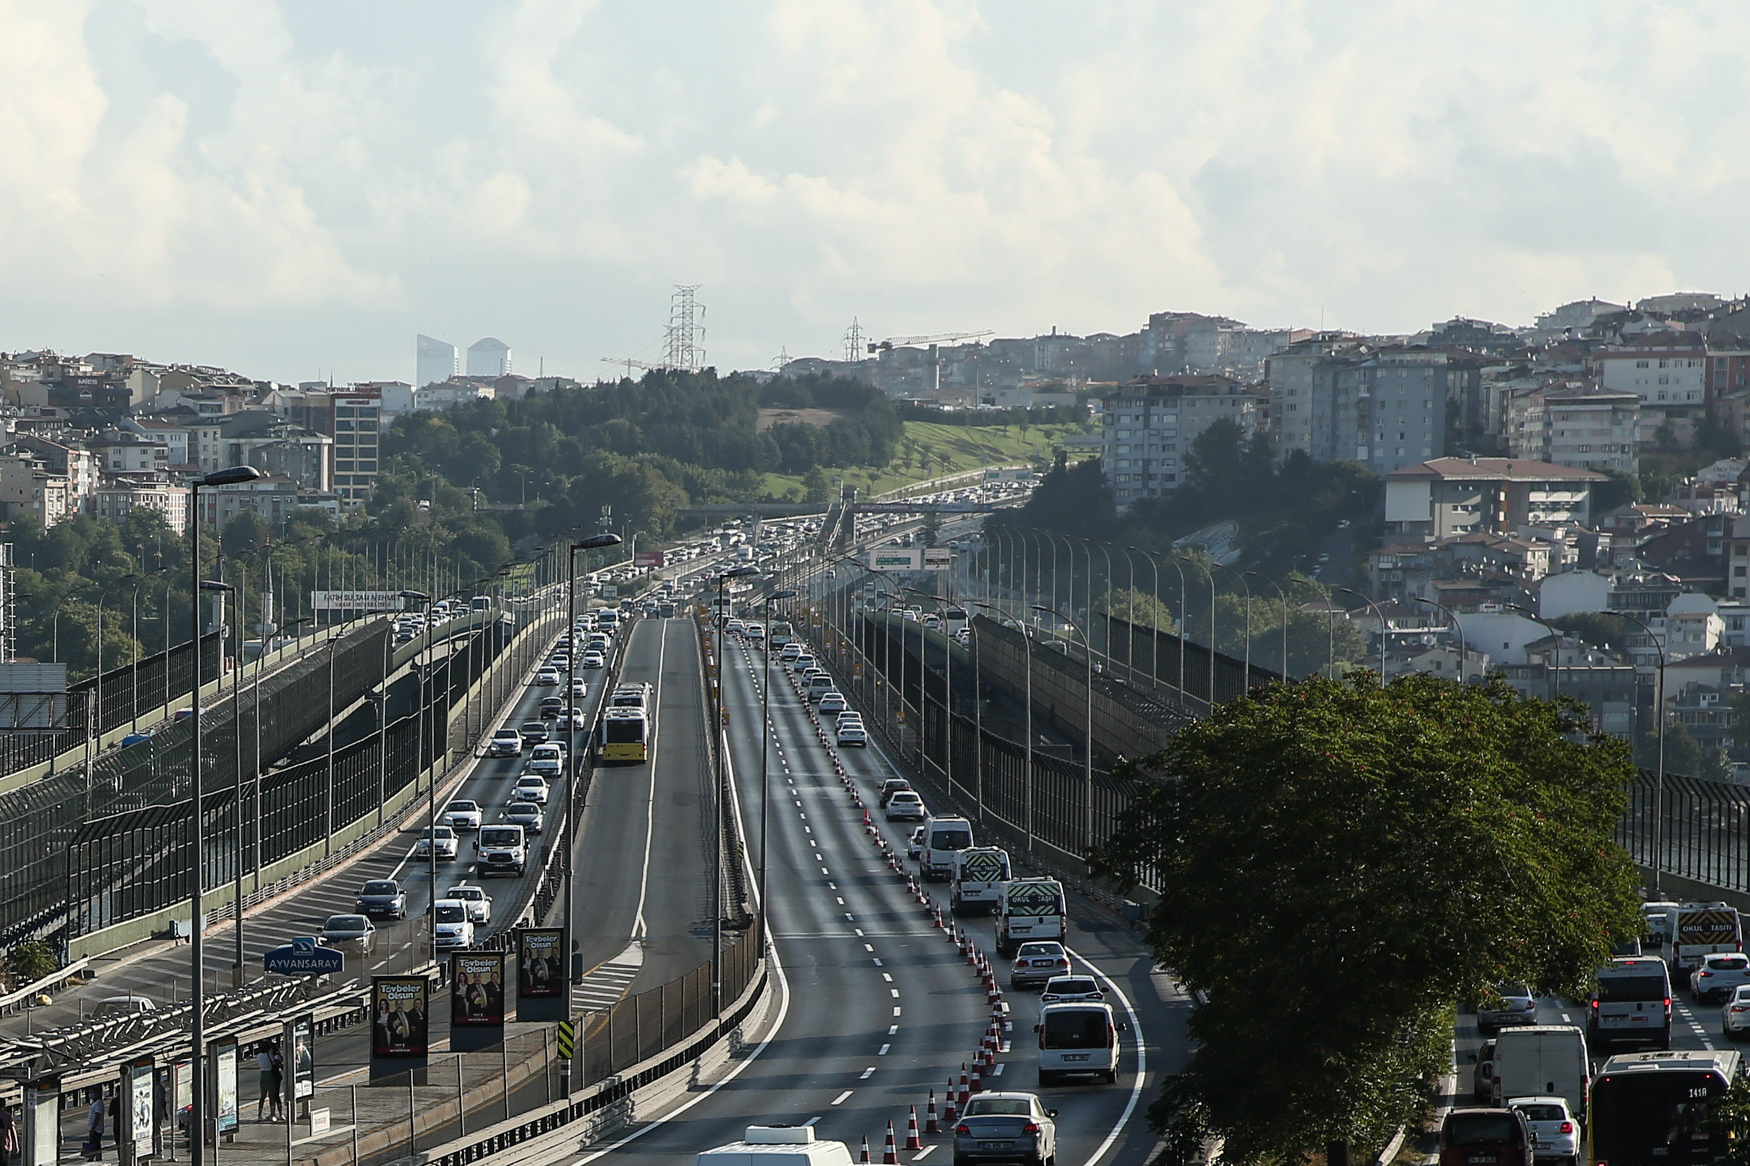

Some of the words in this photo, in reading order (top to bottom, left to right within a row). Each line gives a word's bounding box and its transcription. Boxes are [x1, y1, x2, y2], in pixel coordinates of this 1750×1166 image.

[525, 936, 558, 944] Tövbeler
[269, 960, 338, 968] AYVANSARAY
[459, 958, 498, 968] Tövbeler
[380, 984, 422, 994] Tövbeler
[388, 992, 414, 1000] Olsun
[1688, 1088, 1707, 1098] 141A
